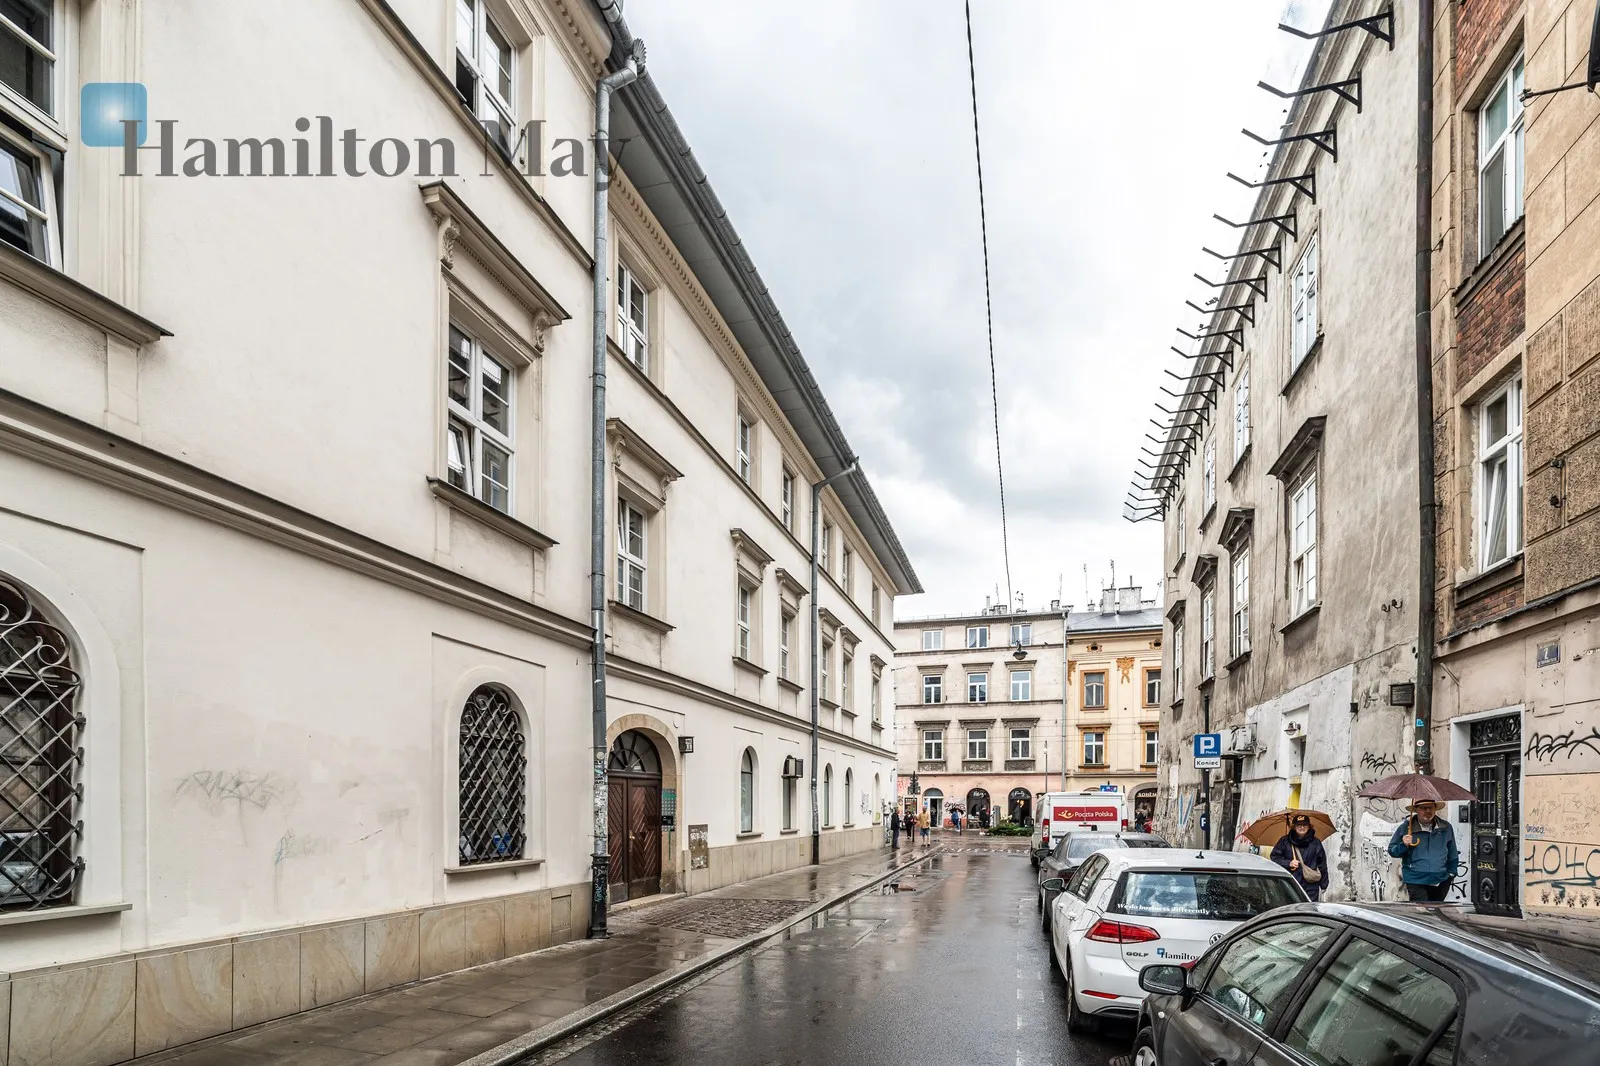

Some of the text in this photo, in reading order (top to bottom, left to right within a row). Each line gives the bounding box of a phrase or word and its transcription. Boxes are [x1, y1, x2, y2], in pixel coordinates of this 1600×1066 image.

[1200, 736, 1214, 755] P
[1139, 904, 1171, 912] business
[1171, 905, 1210, 915] differently
